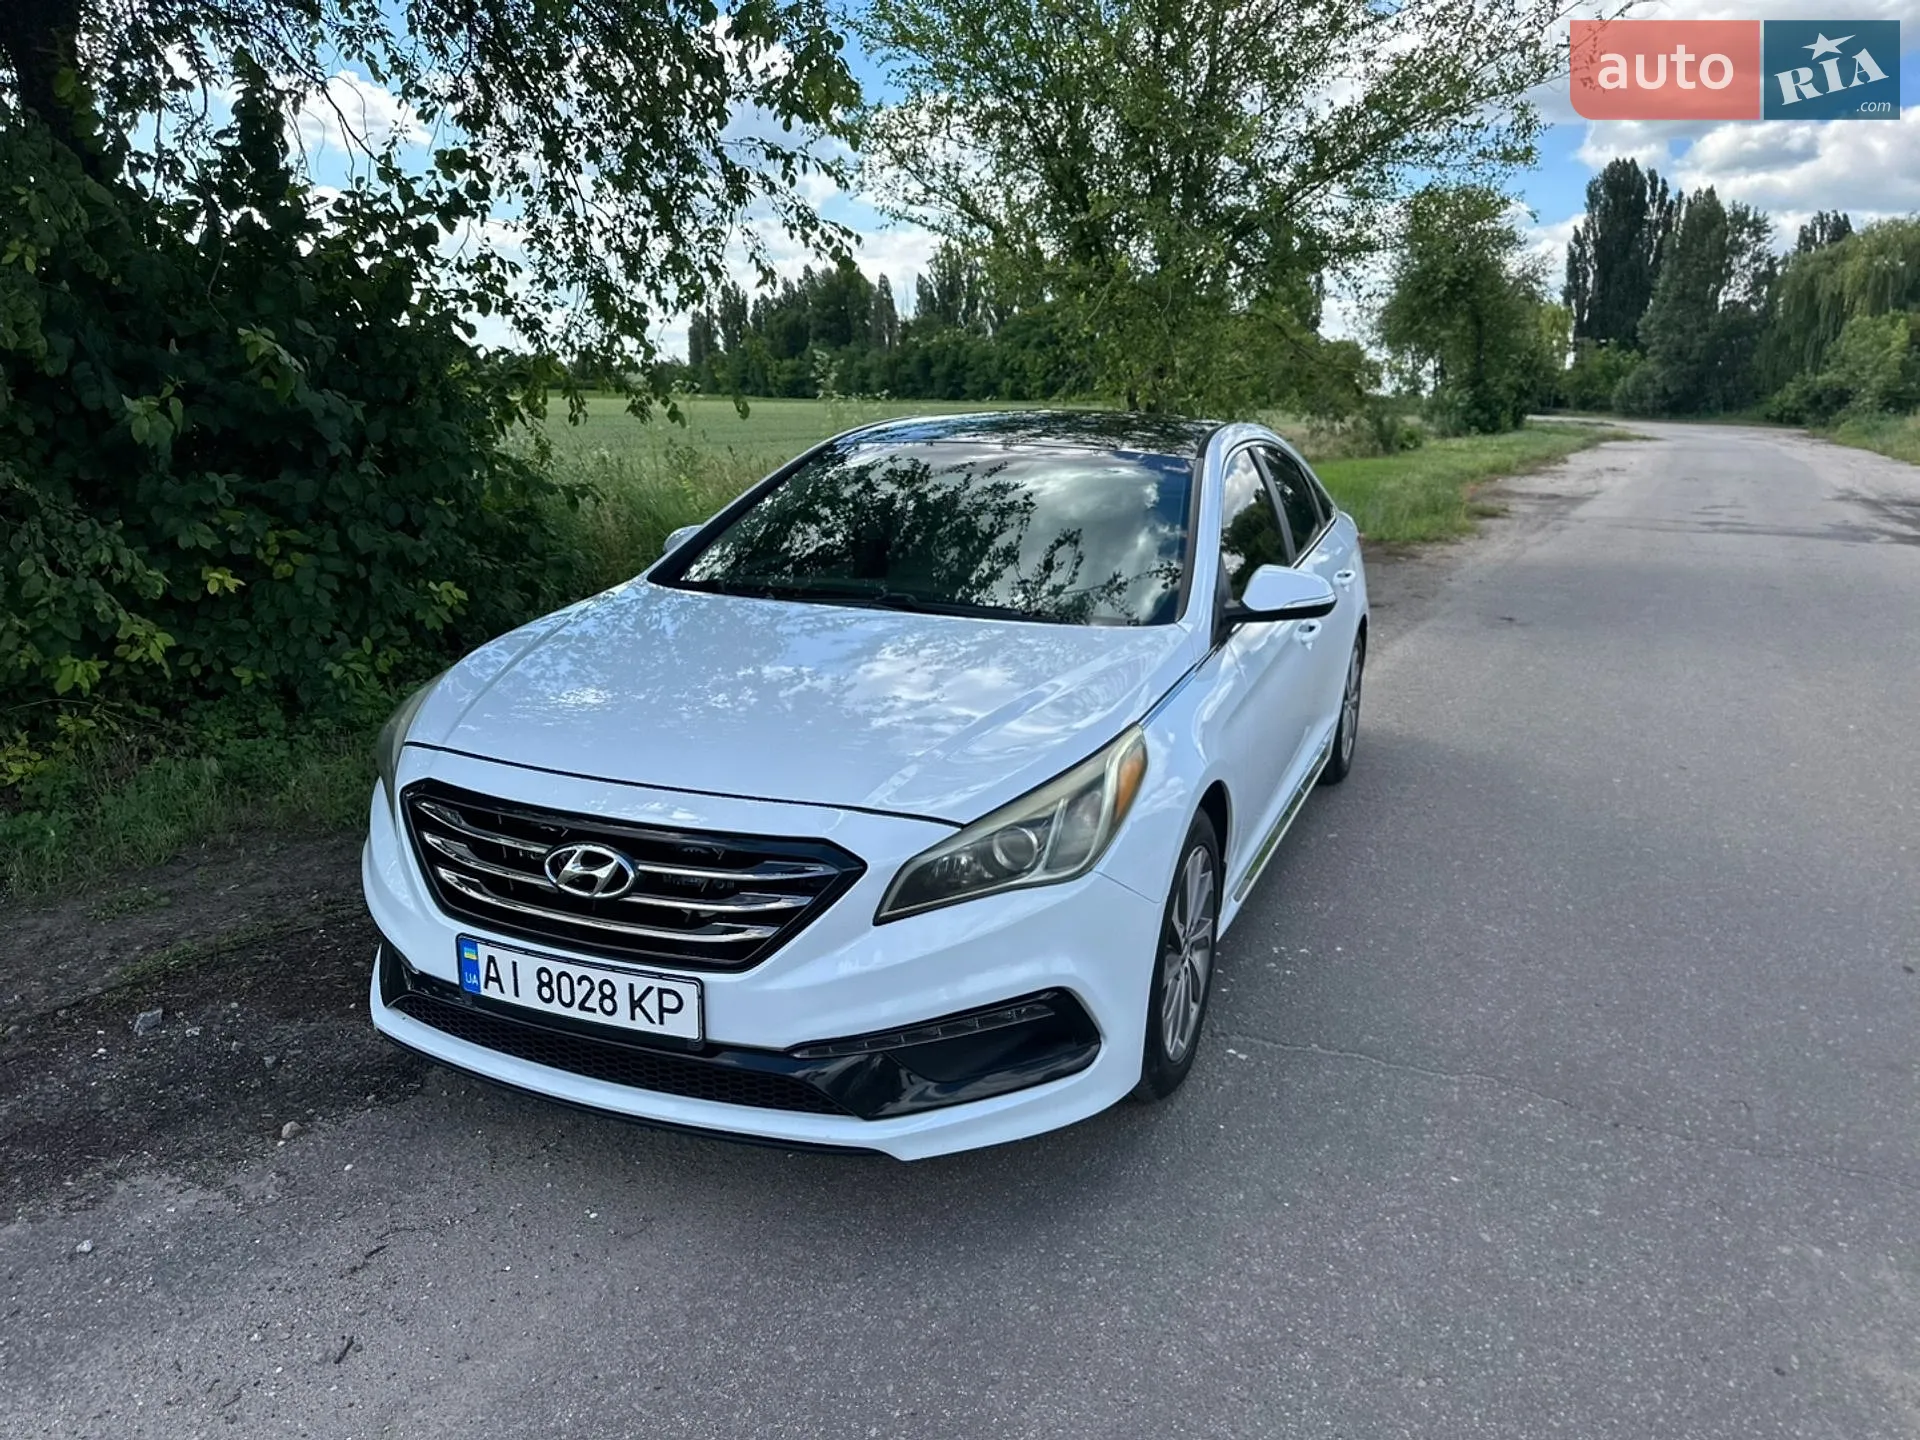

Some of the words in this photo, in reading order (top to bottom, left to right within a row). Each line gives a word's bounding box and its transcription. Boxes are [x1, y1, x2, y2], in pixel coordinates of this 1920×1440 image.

[464, 971, 479, 986] UA
[536, 966, 617, 1016] 8028
[628, 983, 684, 1025] KP
